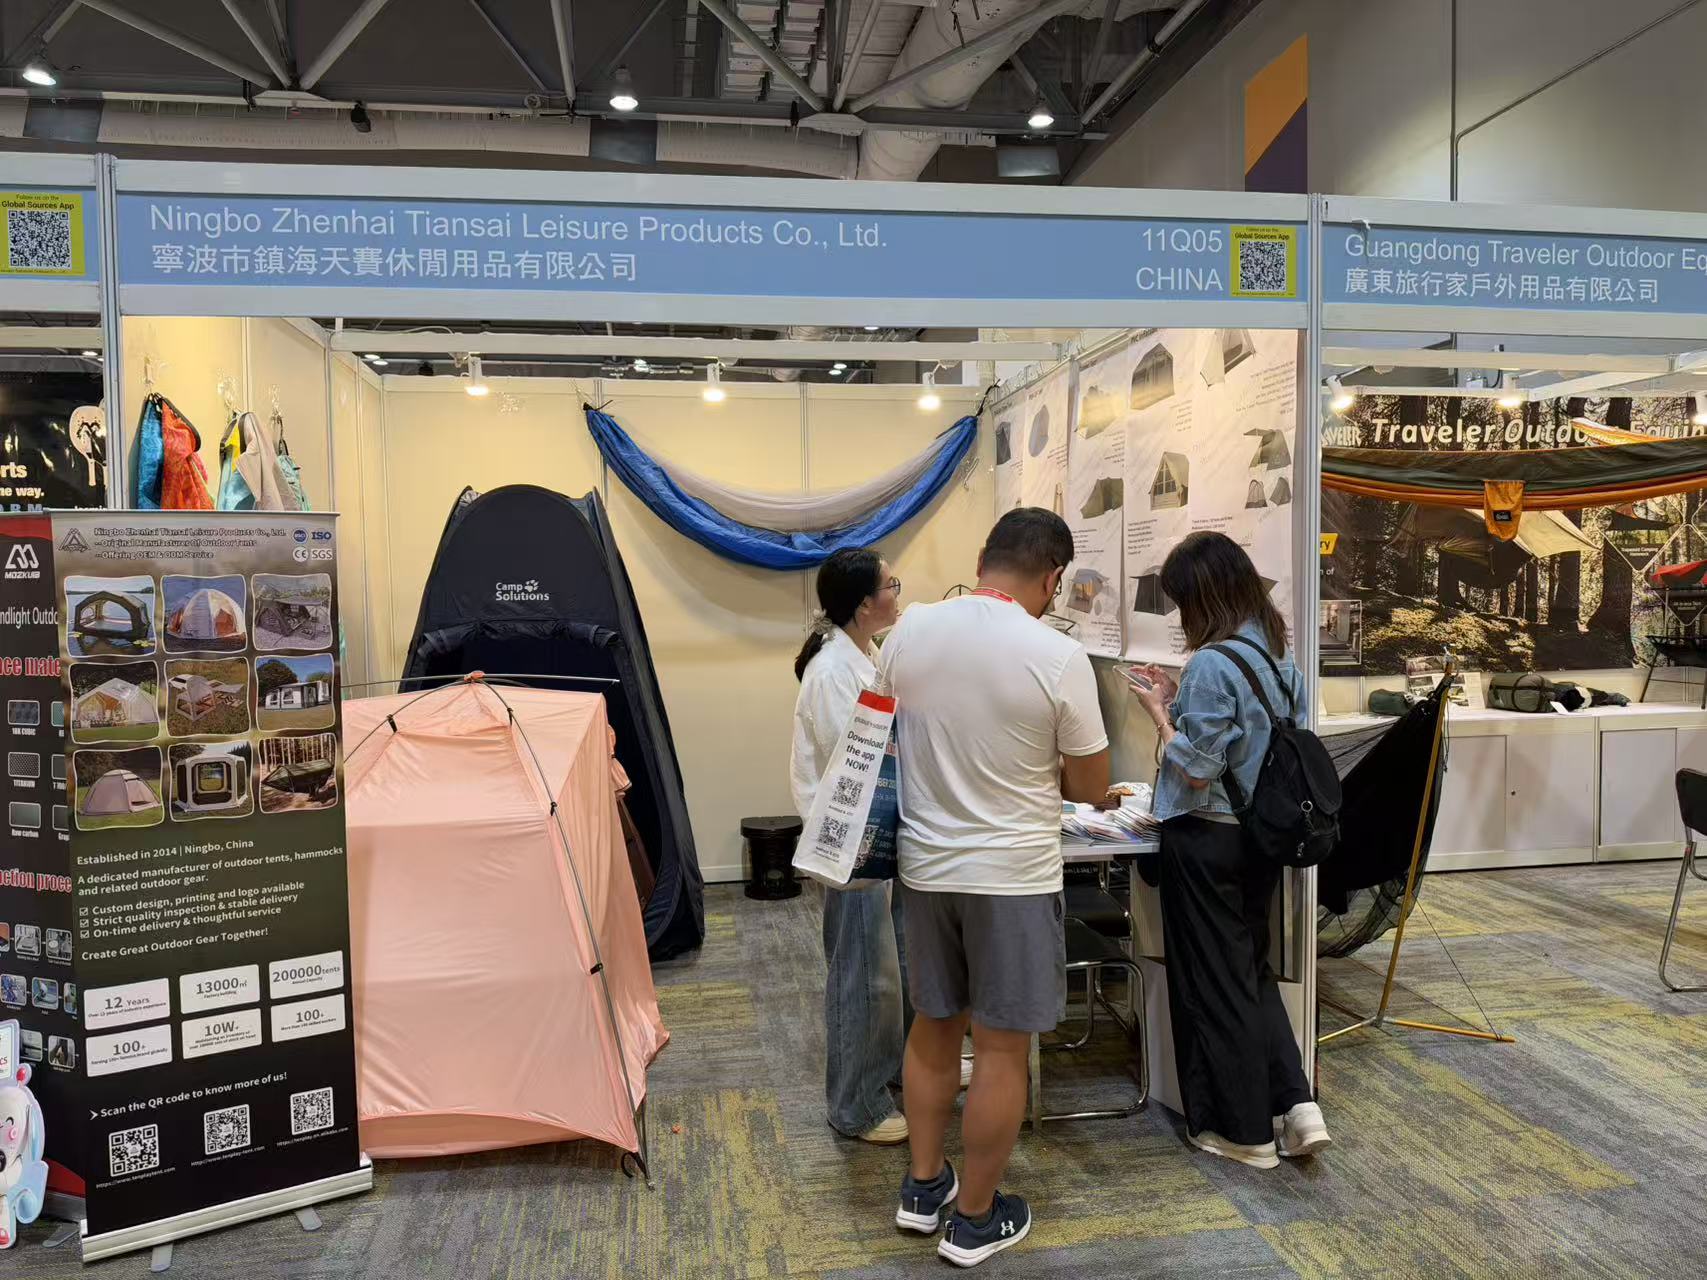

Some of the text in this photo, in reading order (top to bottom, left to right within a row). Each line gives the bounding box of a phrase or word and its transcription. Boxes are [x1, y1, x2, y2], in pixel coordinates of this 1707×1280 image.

[27, 201, 58, 209] Sources
[60, 202, 75, 210] App
[150, 205, 888, 250] Ningbo Zhenhai Tiansai Leisure Products Co., Ltd.
[1142, 228, 1223, 253] 11Q05
[1345, 235, 1480, 266] Guangdong
[1488, 240, 1578, 267] Traveler
[1586, 244, 1675, 269] Outdoor
[1136, 267, 1224, 291] CHINA
[1344, 268, 1658, 303] 廣東旅行家戶外用品有限公司
[1371, 418, 1592, 443] Traveler Outdo
[15, 487, 45, 498] way.
[94, 528, 124, 537] Ningbo
[311, 531, 332, 540] ISO
[137, 551, 155, 559] OEM
[165, 551, 183, 559] ODM
[184, 551, 214, 559] Service
[311, 549, 332, 559] SGS
[495, 582, 523, 592] Camp
[495, 591, 550, 601] Solutions
[847, 730, 885, 749] Download
[846, 745, 875, 762] the app
[845, 758, 870, 773] NOW!
[77, 840, 254, 865] Established in 2014 Ningbo, China
[77, 847, 343, 885] A dedicated manufacturer of outdoor tents, hammocks
[78, 874, 209, 896] and related outdoor gear.
[92, 881, 305, 915] Custom design, printing and logo available
[93, 894, 298, 927] Strict quality inspection & stable delivery
[93, 907, 282, 938] On-time delivery & thoughtful service
[81, 927, 269, 960] Create Great Outdoor Gear Together!
[104, 996, 150, 1010] 12 Years
[100, 1071, 287, 1118] Scan the QR code to know more of us!
